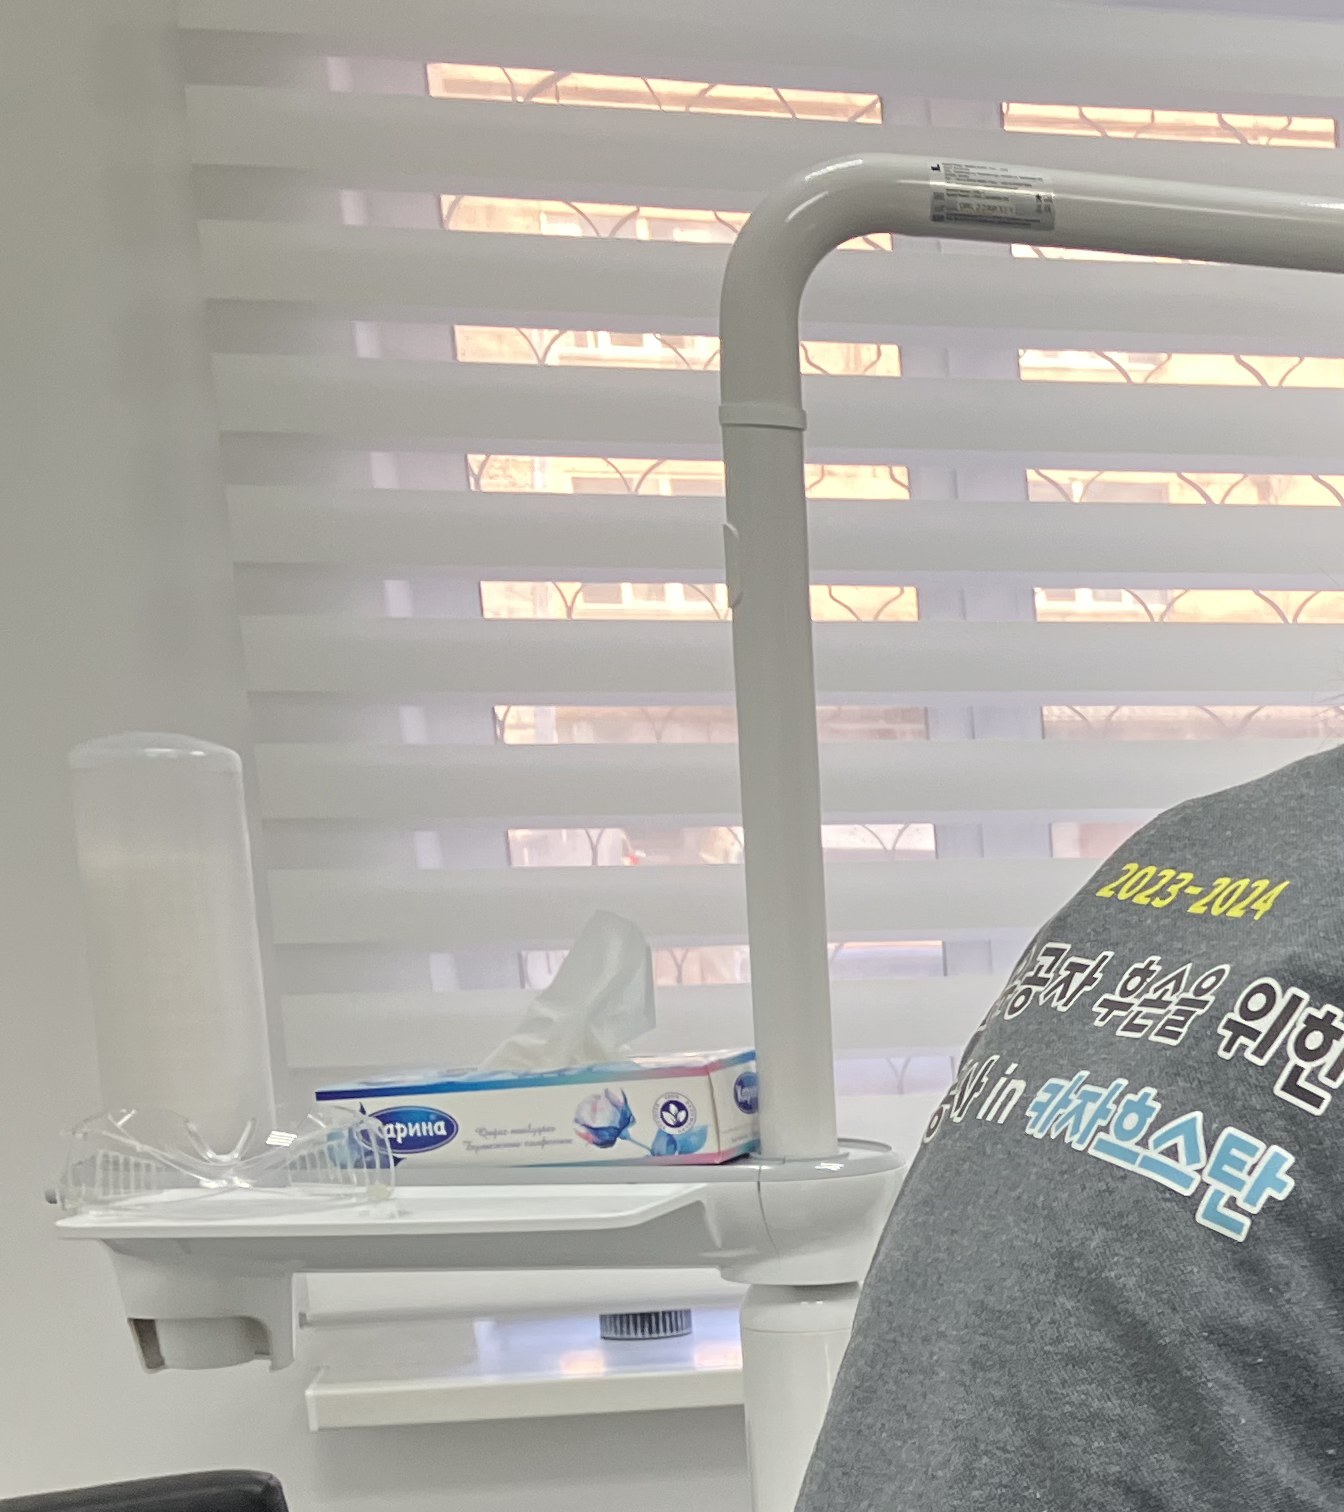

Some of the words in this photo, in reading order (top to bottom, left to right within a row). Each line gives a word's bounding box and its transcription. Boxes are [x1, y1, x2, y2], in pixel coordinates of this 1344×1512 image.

[1096, 862, 1290, 920] 2023-2024
[1092, 954, 1231, 1045] 후손을
[383, 1120, 447, 1144] арина
[976, 1063, 1026, 1125] in
[1025, 1070, 1295, 1242] 카자흐스탄
